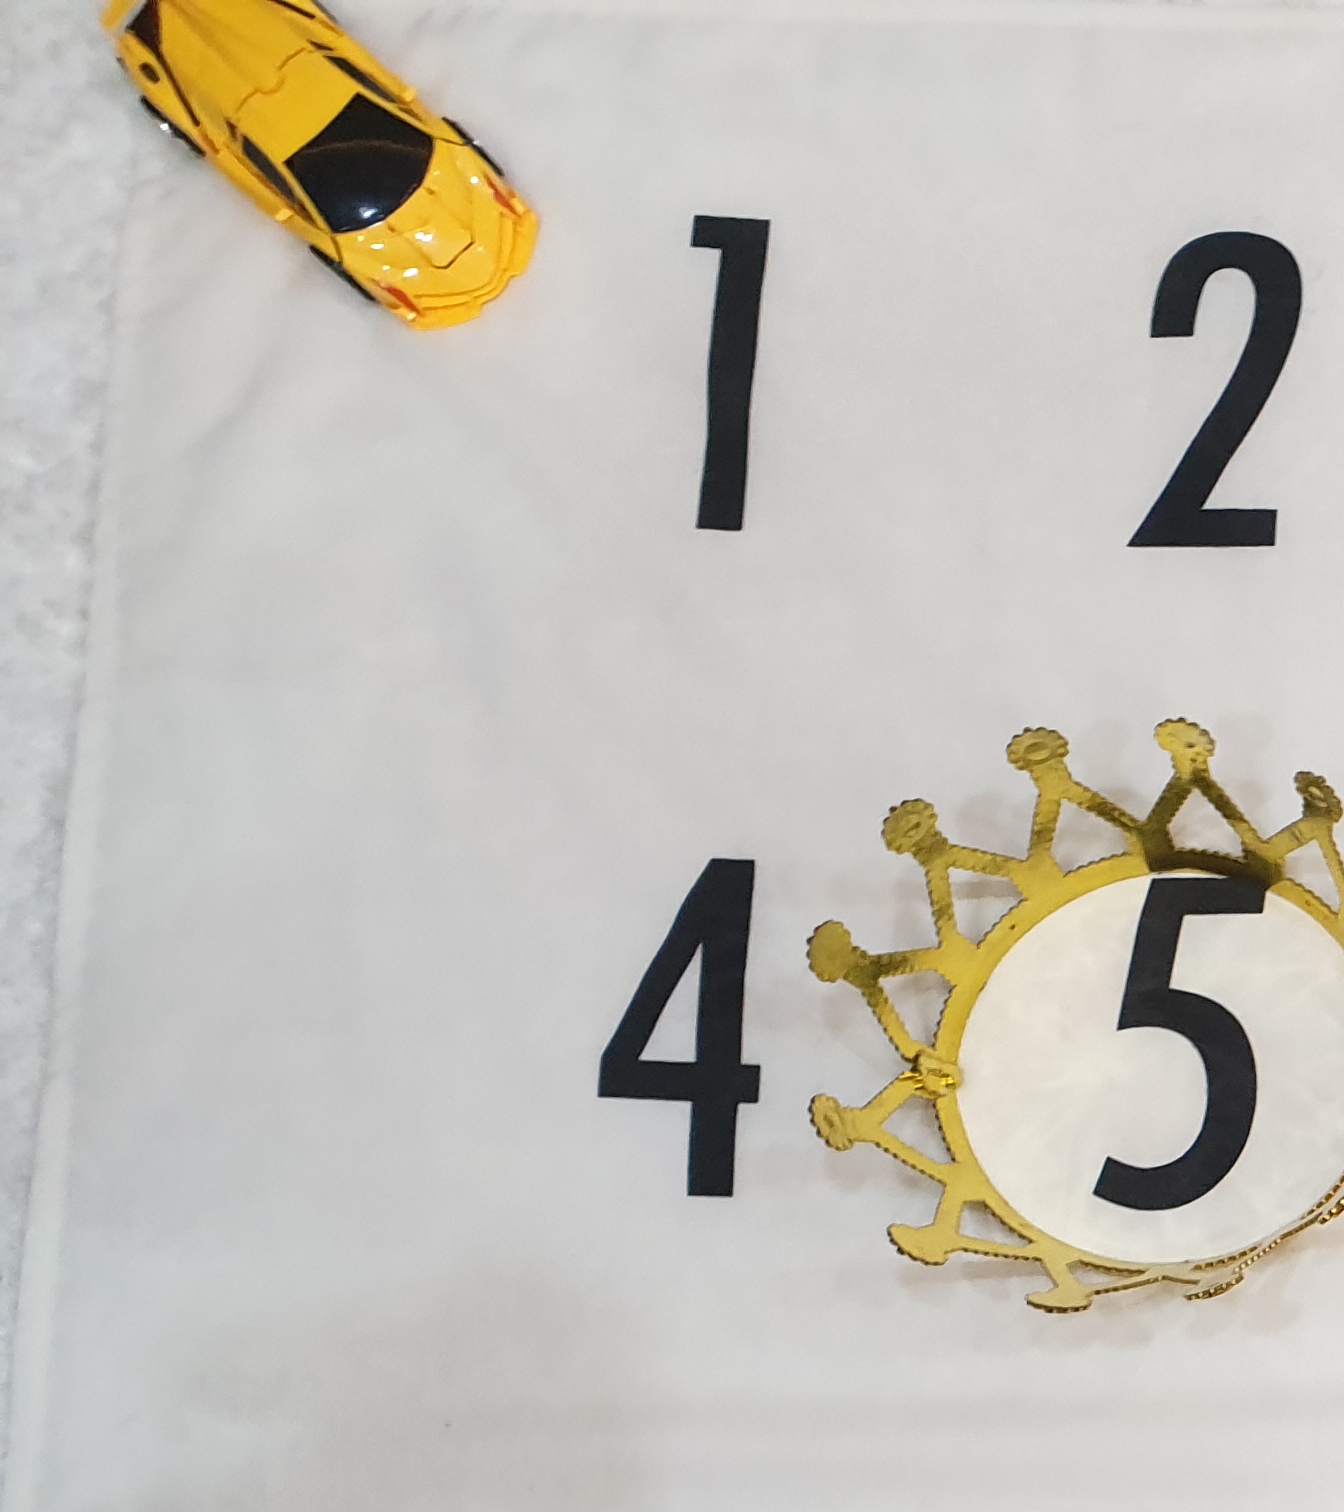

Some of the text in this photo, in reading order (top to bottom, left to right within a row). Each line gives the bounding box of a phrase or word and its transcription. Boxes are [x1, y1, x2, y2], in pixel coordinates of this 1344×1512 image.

[691, 216, 769, 531] 1
[1127, 232, 1301, 547] 2
[599, 859, 760, 1197] 4
[1093, 876, 1267, 1212] 5
